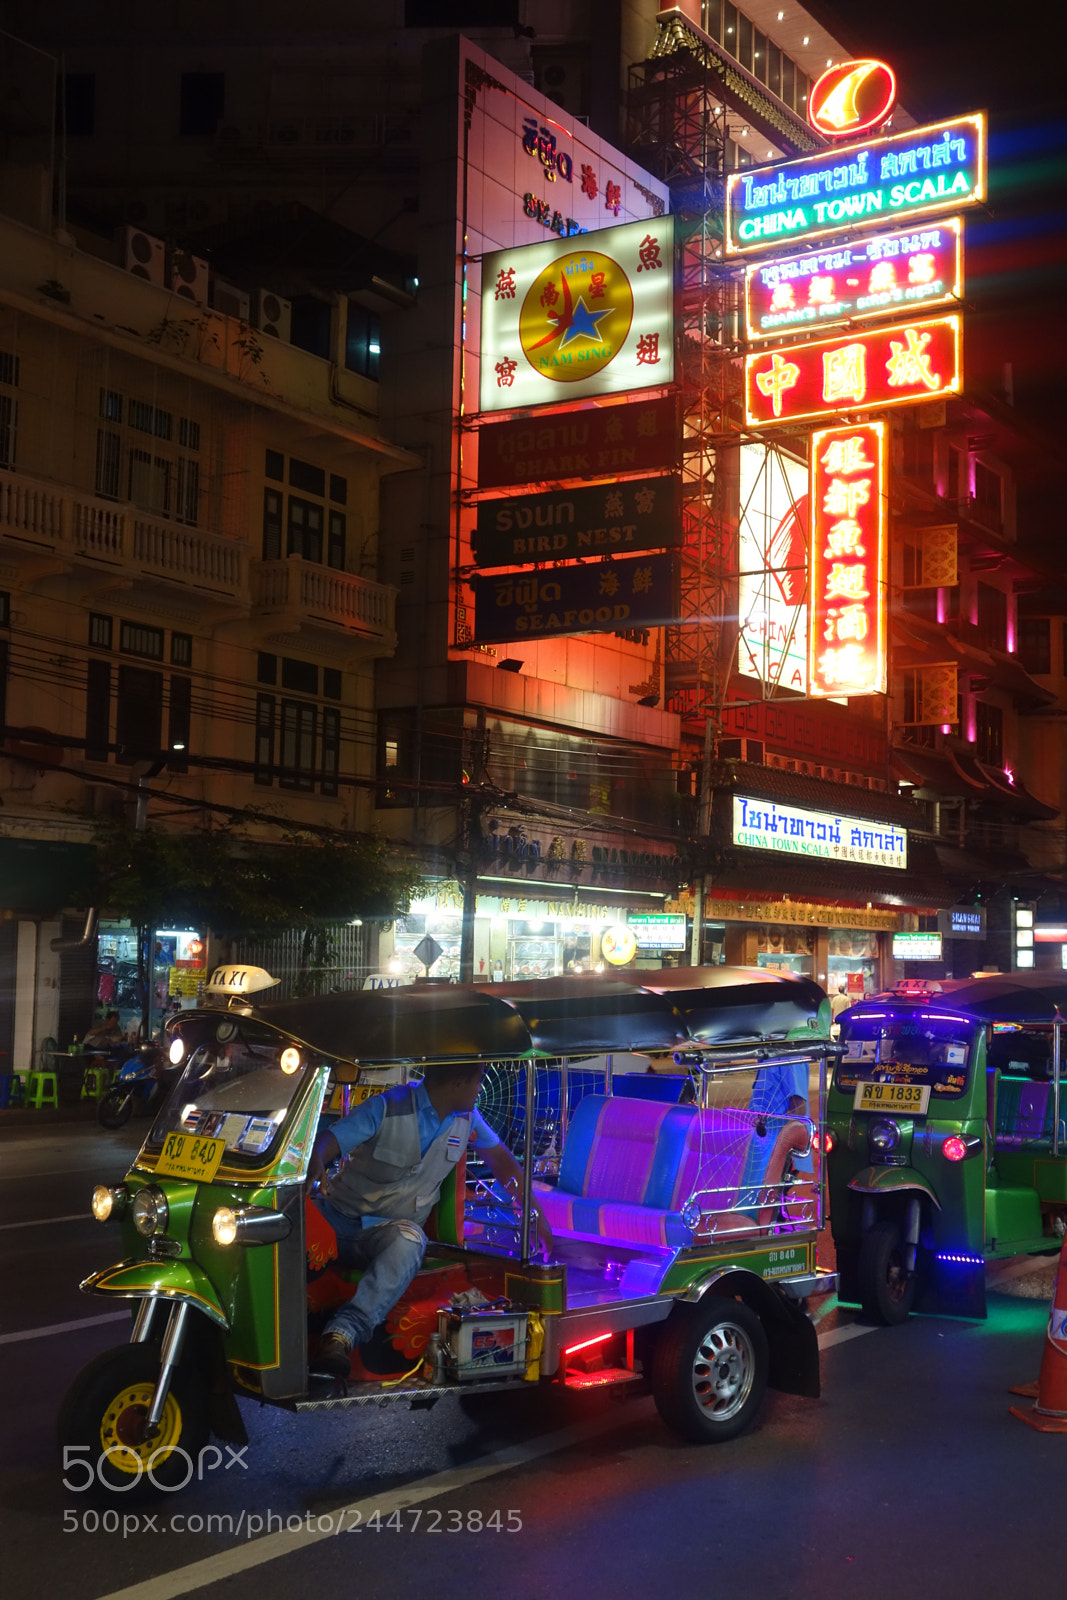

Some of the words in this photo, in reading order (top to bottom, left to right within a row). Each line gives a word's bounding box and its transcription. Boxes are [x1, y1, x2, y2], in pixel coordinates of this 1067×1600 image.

[738, 208, 808, 241] CHINA
[813, 190, 883, 223] TOWN
[889, 172, 970, 208] SCALA
[760, 306, 817, 328] SHARK'S
[906, 280, 944, 299] NEST
[538, 353, 573, 370] NAM
[577, 345, 613, 364] SING
[756, 329, 940, 417] 中國城
[514, 457, 590, 477] SHARK
[600, 449, 637, 466] FIN
[496, 501, 575, 532] รังนก
[513, 533, 568, 554] BIRD
[577, 525, 637, 547] NEST
[515, 604, 630, 631] SEAFOOD
[737, 831, 768, 848] CHINA
[771, 837, 799, 853] TOWN
[801, 842, 830, 857] SCALA
[851, 825, 904, 853] สกาล่า
[213, 971, 248, 986] TAXI
[864, 1085, 884, 1099] สข
[890, 1087, 921, 1101] 1833
[191, 1139, 217, 1164] 840
[781, 1249, 797, 1261] 840
